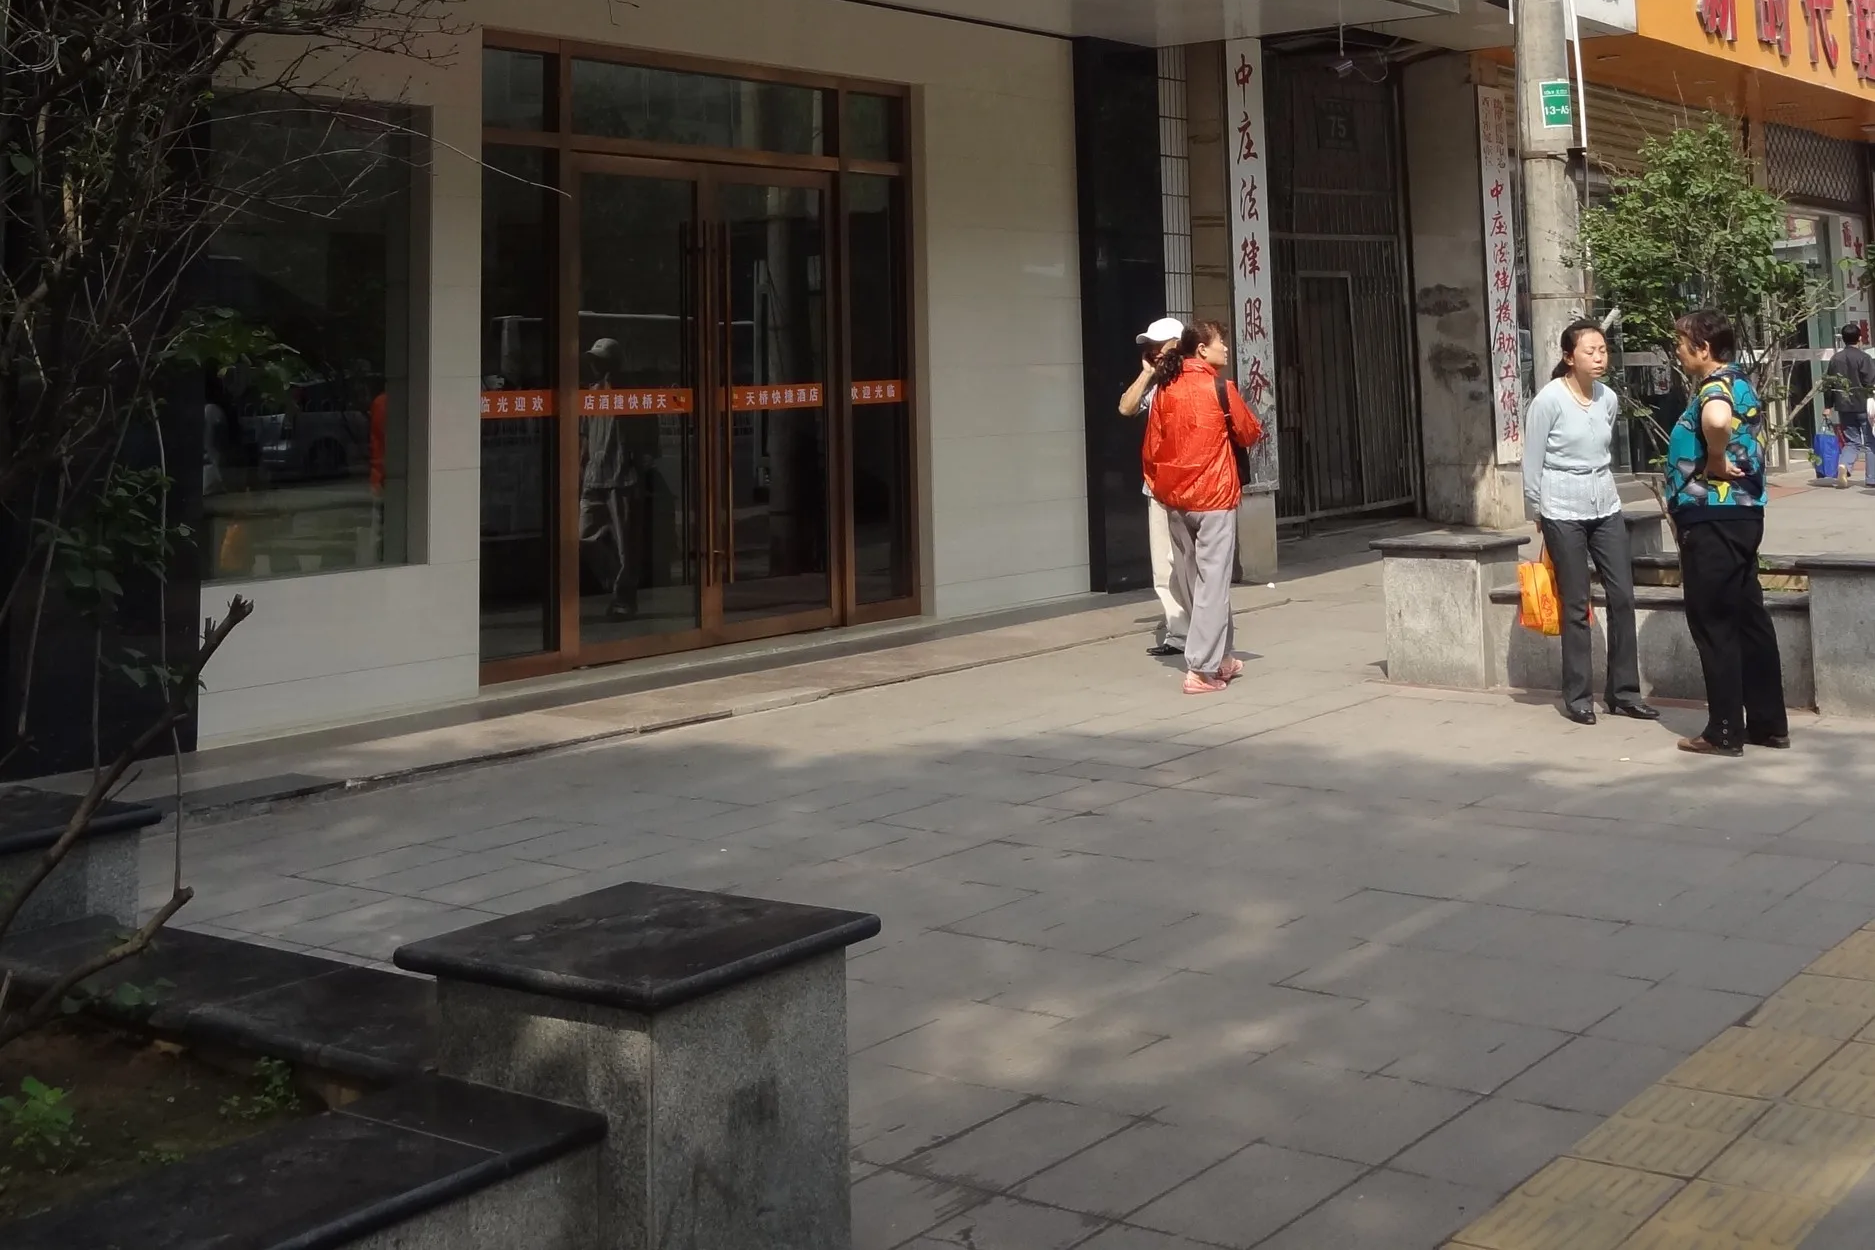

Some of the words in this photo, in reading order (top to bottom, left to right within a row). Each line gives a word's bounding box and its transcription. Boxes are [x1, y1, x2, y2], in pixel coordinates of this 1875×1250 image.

[1326, 115, 1347, 138] 75
[746, 387, 819, 406] 天桥快捷酒店
